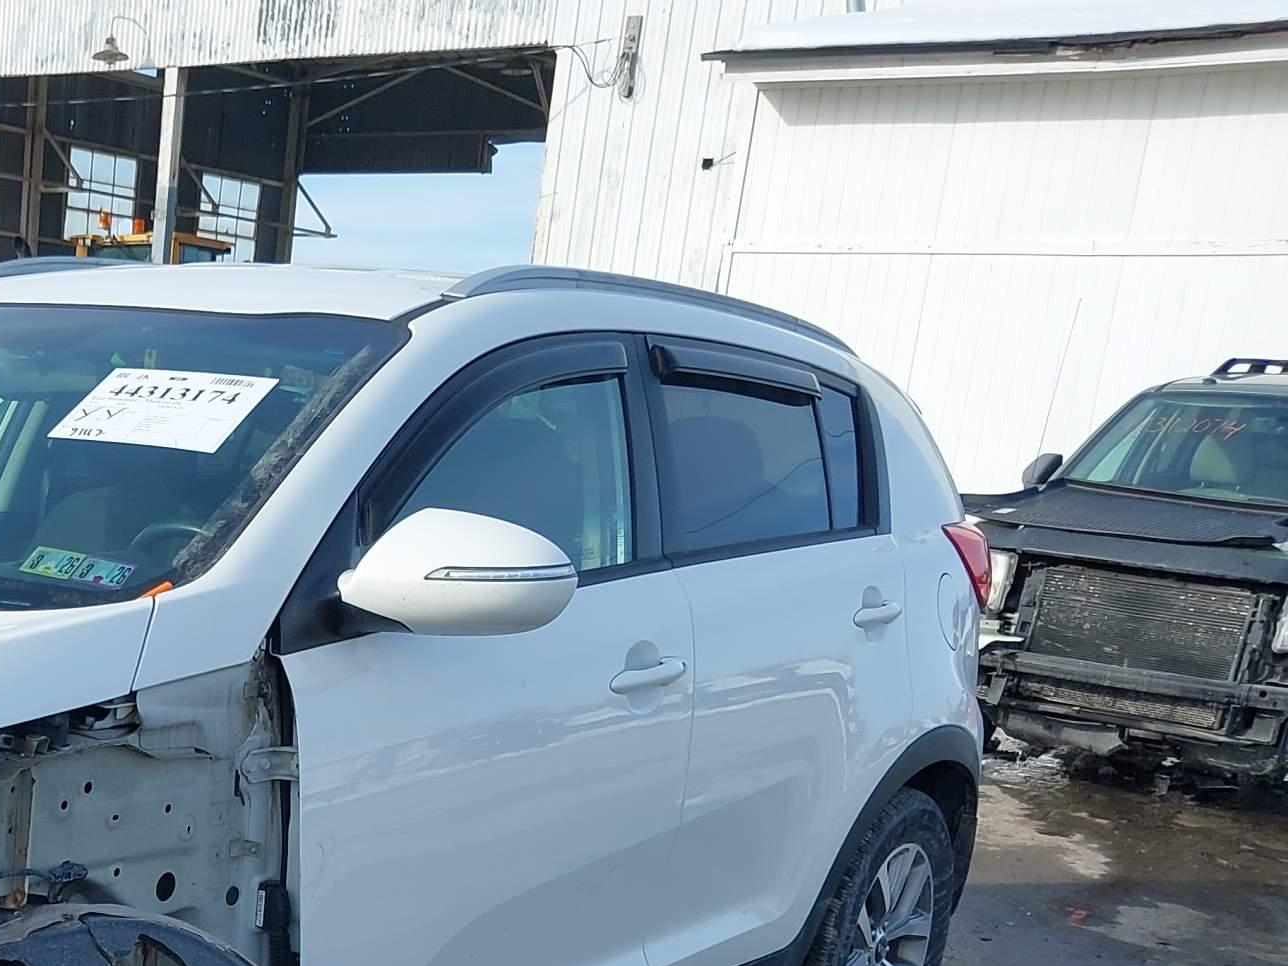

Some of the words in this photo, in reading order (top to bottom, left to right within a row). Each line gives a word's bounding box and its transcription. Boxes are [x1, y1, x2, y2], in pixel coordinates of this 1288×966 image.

[108, 384, 241, 405] 44313174
[29, 554, 45, 570] 3
[57, 556, 81, 574] 26
[78, 563, 95, 578] 3
[109, 566, 132, 585] 26
